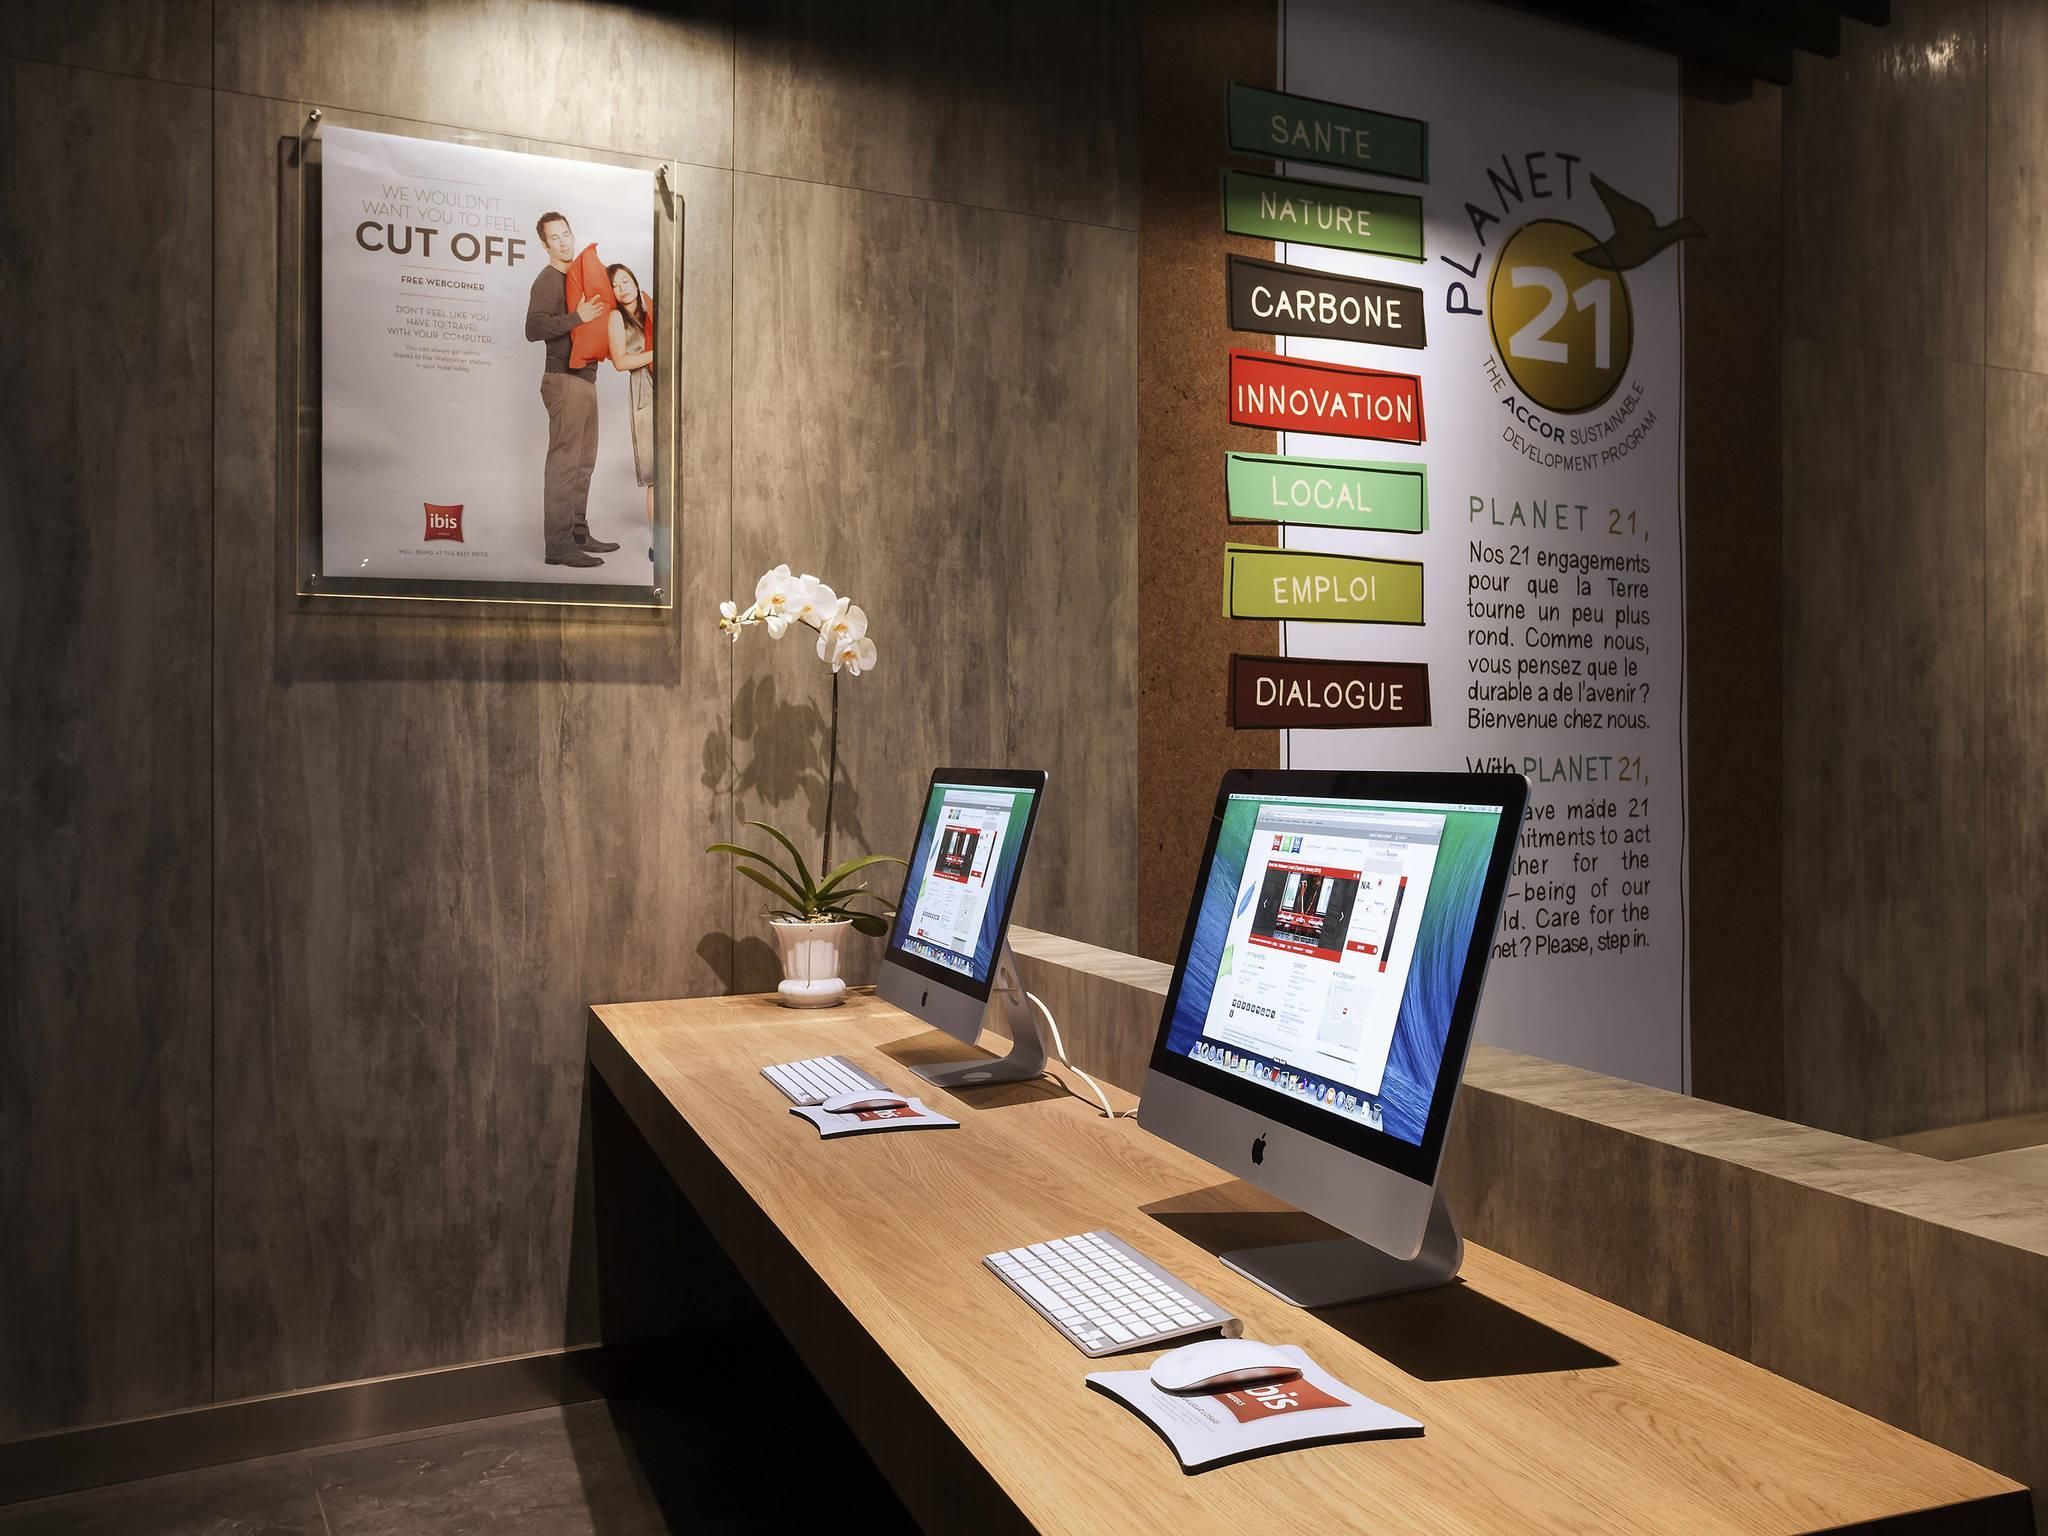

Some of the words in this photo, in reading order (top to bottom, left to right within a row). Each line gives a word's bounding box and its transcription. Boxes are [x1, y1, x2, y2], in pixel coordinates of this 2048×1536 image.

[1271, 115, 1371, 159] SANTE
[382, 184, 409, 201] WE
[415, 188, 504, 212] WOULDN'T
[362, 200, 412, 219] WANT
[417, 207, 453, 224] YOU
[459, 211, 480, 227] TO
[485, 215, 521, 233] FEEL
[1261, 191, 1371, 236] NATURE
[356, 221, 438, 257] CUT
[450, 232, 526, 267] OFF
[1440, 151, 1581, 316] PLANET
[401, 275, 424, 285] FREE
[426, 278, 485, 291] WEBCORNER
[395, 305, 425, 315] DON'T
[427, 308, 448, 318] FEEL
[450, 311, 469, 319] LIKE
[470, 312, 490, 321] YOU
[1251, 285, 1402, 329] CARBONE
[1508, 265, 1611, 370] 21
[387, 327, 411, 336] WITH
[413, 329, 438, 339] YOUR
[406, 318, 430, 327] HAVE
[433, 320, 445, 329] TO
[447, 321, 479, 331] TRAVEL
[1238, 383, 1412, 423] INNOVATION
[1482, 354, 1507, 393] THE
[1502, 395, 1565, 445] ACCOR
[1570, 380, 1645, 446] SUSTAINABLE
[1503, 426, 1599, 472] DEVELOPMENT
[1601, 410, 1658, 466] PROGRAM
[1272, 476, 1372, 512] LOCAL
[430, 513, 458, 529] ibis
[1469, 495, 1589, 532] PLANET
[1608, 508, 1649, 543] 21,
[1469, 540, 1504, 565] Nos
[1510, 544, 1529, 565] 21
[1537, 550, 1650, 574] engagements
[1273, 575, 1376, 604] EMPLOI
[1468, 574, 1510, 595] pour
[1528, 578, 1559, 598] que
[1577, 575, 1592, 596] la
[1607, 577, 1649, 599] Terre
[1467, 597, 1525, 620] tourne
[1538, 605, 1560, 621] un
[1572, 606, 1604, 627] peu
[1615, 604, 1650, 629] plus
[1468, 626, 1514, 647] rond.
[1525, 626, 1593, 649] Comme
[1604, 633, 1650, 655] nous,
[1468, 657, 1512, 675] vous
[1518, 659, 1582, 680] pensez
[1587, 660, 1618, 680] que
[1624, 656, 1638, 677] le
[1255, 676, 1403, 711] DIALOGUE
[1467, 680, 1533, 702] durable
[1537, 686, 1549, 702] a
[1553, 681, 1573, 702] de
[1468, 707, 1558, 729] Bienvenue
[1563, 708, 1603, 729] chez
[1607, 713, 1650, 729] nous.
[1523, 754, 1612, 783] PLANET
[1618, 756, 1649, 786] 21,
[1525, 804, 1555, 821] ave
[1567, 798, 1617, 820] made
[1628, 798, 1648, 818] 21
[1521, 828, 1596, 849] itments
[1600, 825, 1617, 845] to
[1623, 824, 1651, 844] act
[1573, 852, 1598, 872] for
[1621, 850, 1649, 871] the
[1591, 877, 1608, 898] of
[1622, 879, 1651, 896] our
[1503, 909, 1526, 931] ld.
[1536, 907, 1580, 929] Care
[1589, 904, 1615, 925] for
[1622, 902, 1649, 923] the
[1536, 935, 1593, 956] Please,
[1597, 931, 1630, 954] step
[1633, 928, 1650, 948] in.
[1244, 1383, 1300, 1411] bis
